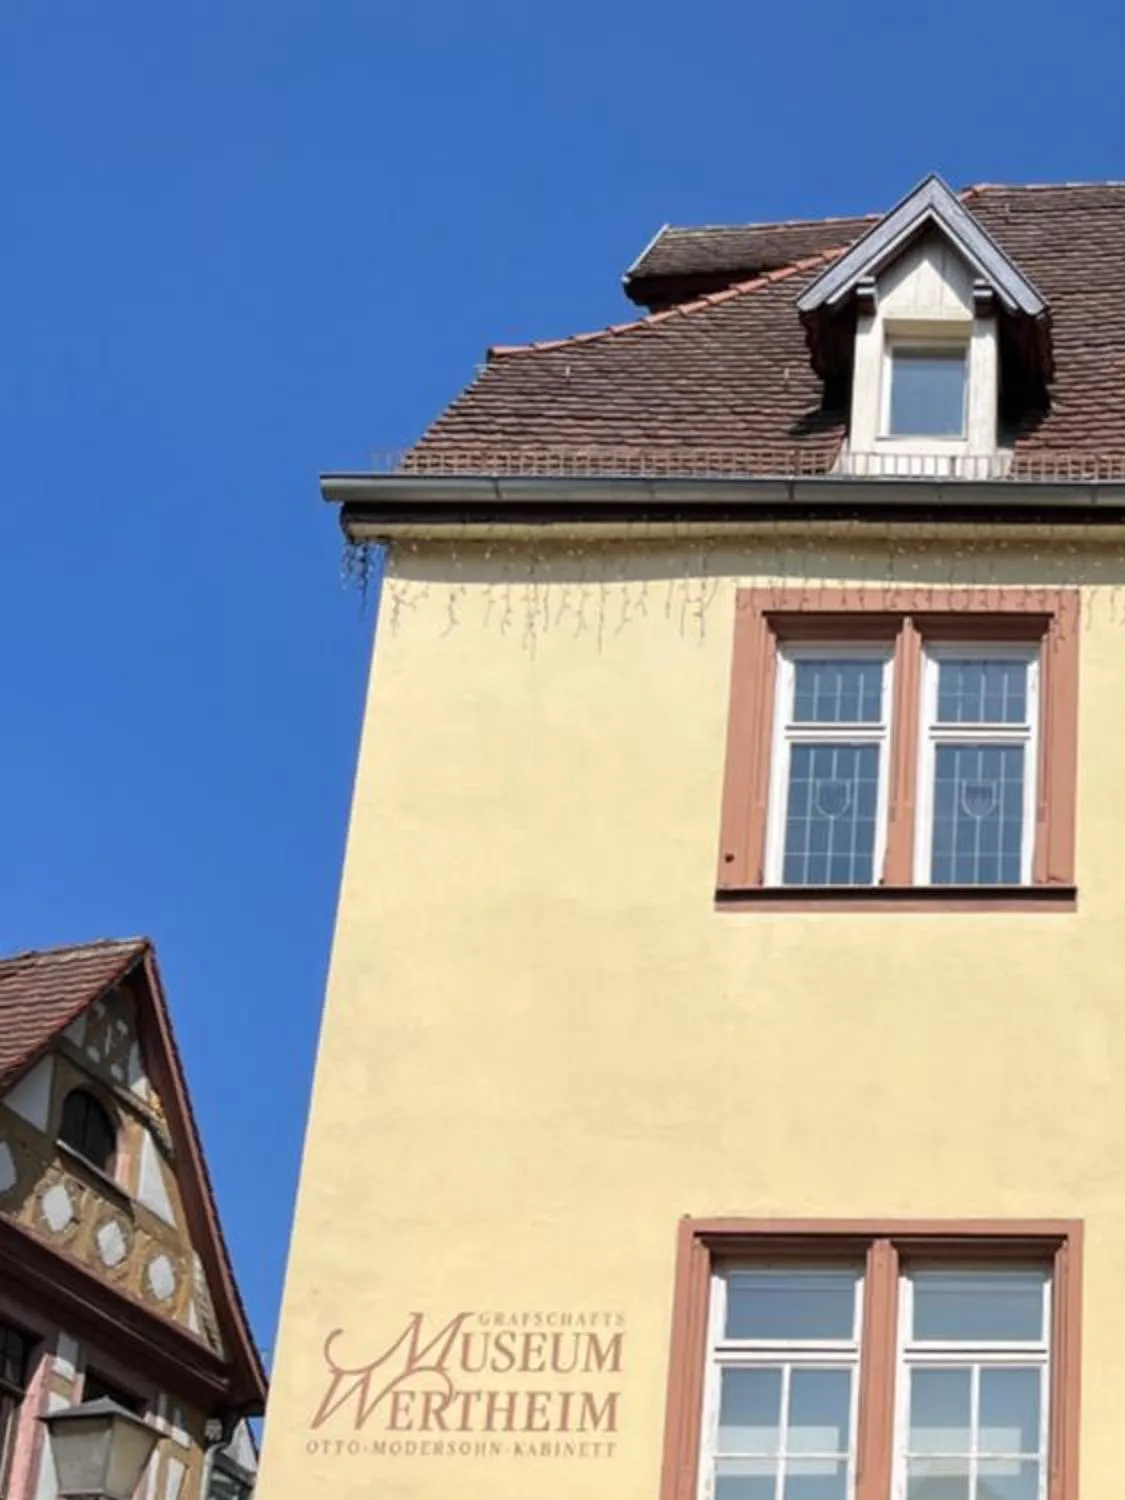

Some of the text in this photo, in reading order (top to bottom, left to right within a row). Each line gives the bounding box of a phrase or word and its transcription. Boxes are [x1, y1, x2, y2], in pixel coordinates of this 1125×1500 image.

[324, 1311, 625, 1374] MUSEUM
[477, 1311, 626, 1326] GRAFSCHAFTS
[310, 1367, 621, 1433] WERTHEIM
